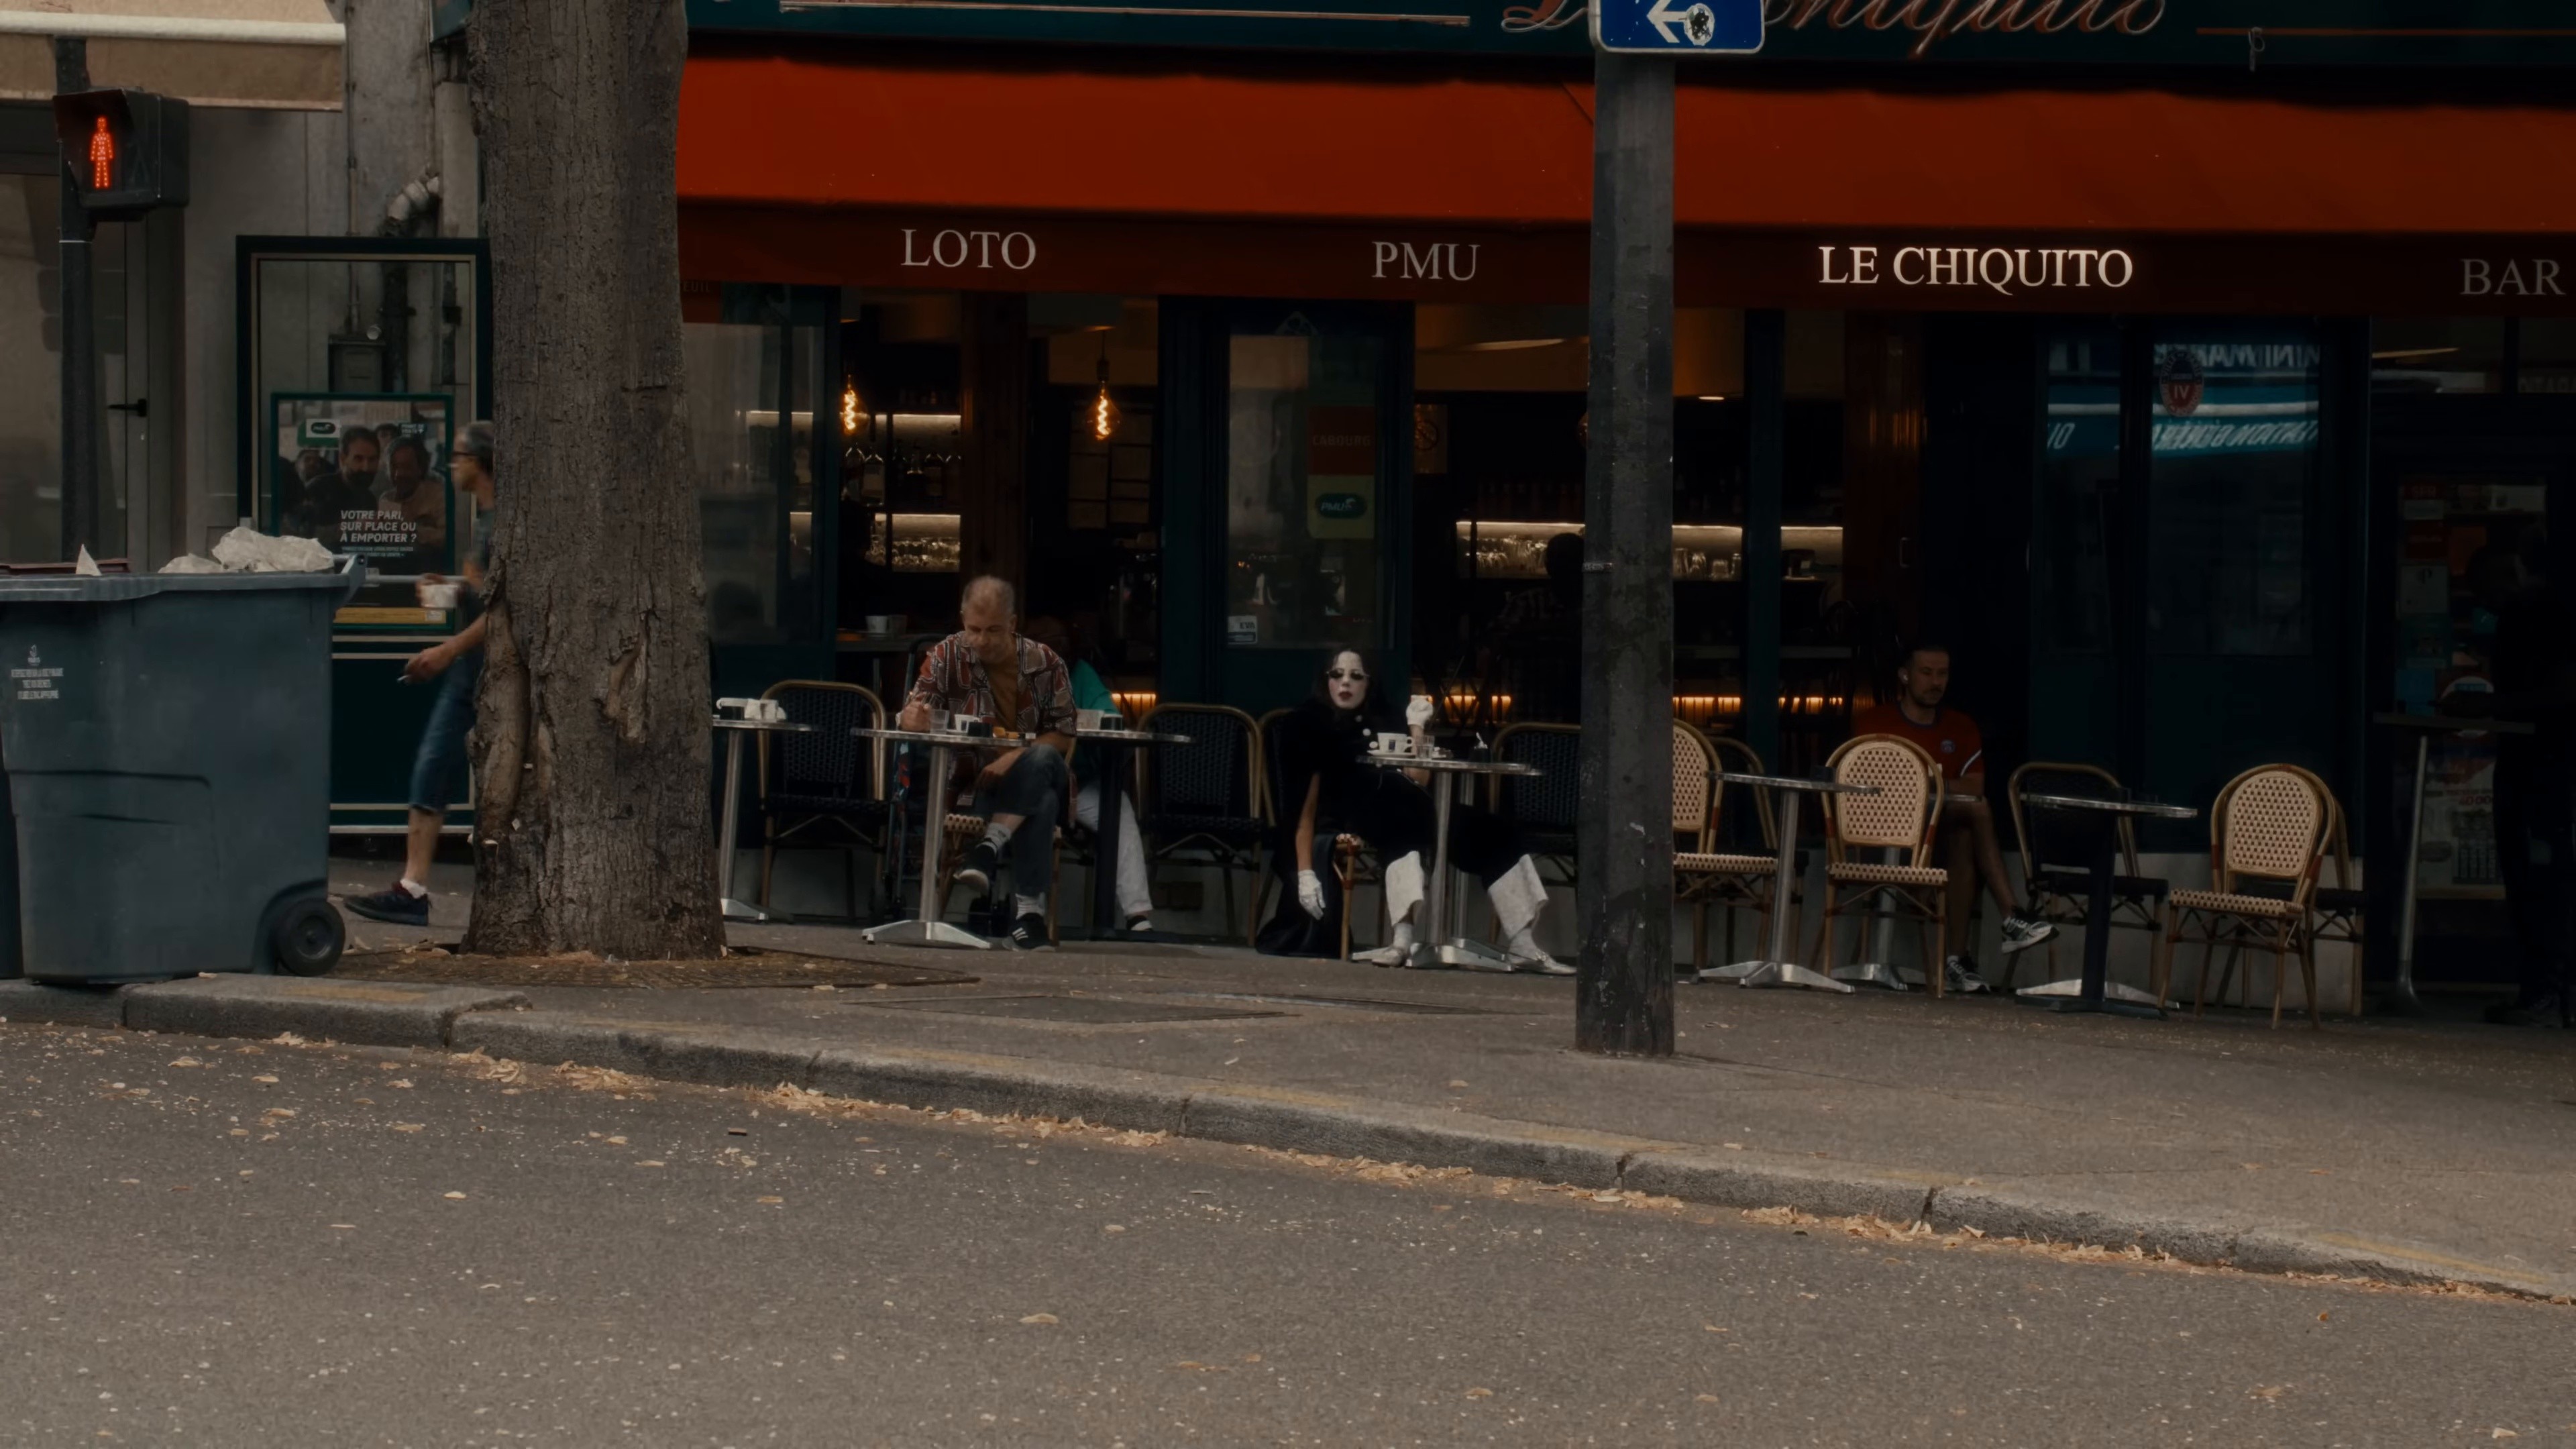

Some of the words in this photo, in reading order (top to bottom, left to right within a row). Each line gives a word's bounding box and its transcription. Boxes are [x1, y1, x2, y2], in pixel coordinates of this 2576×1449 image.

[900, 228, 1036, 270] LOTO
[1371, 241, 1481, 281] PMU
[1818, 246, 1879, 284] LE
[1893, 246, 2133, 296] CHIQUITO
[2459, 258, 2567, 295] BAR
[2174, 384, 2190, 400] IV
[1311, 434, 1372, 448] CABOURG
[1320, 501, 1345, 512] PMU
[340, 510, 376, 520] VOTRE
[377, 510, 404, 521] PARI,
[339, 521, 362, 531] SUR
[365, 521, 398, 531] PLACE
[400, 521, 417, 531] OU
[339, 530, 347, 543] À
[351, 533, 408, 543] EMPORTER
[410, 533, 417, 543] ?
